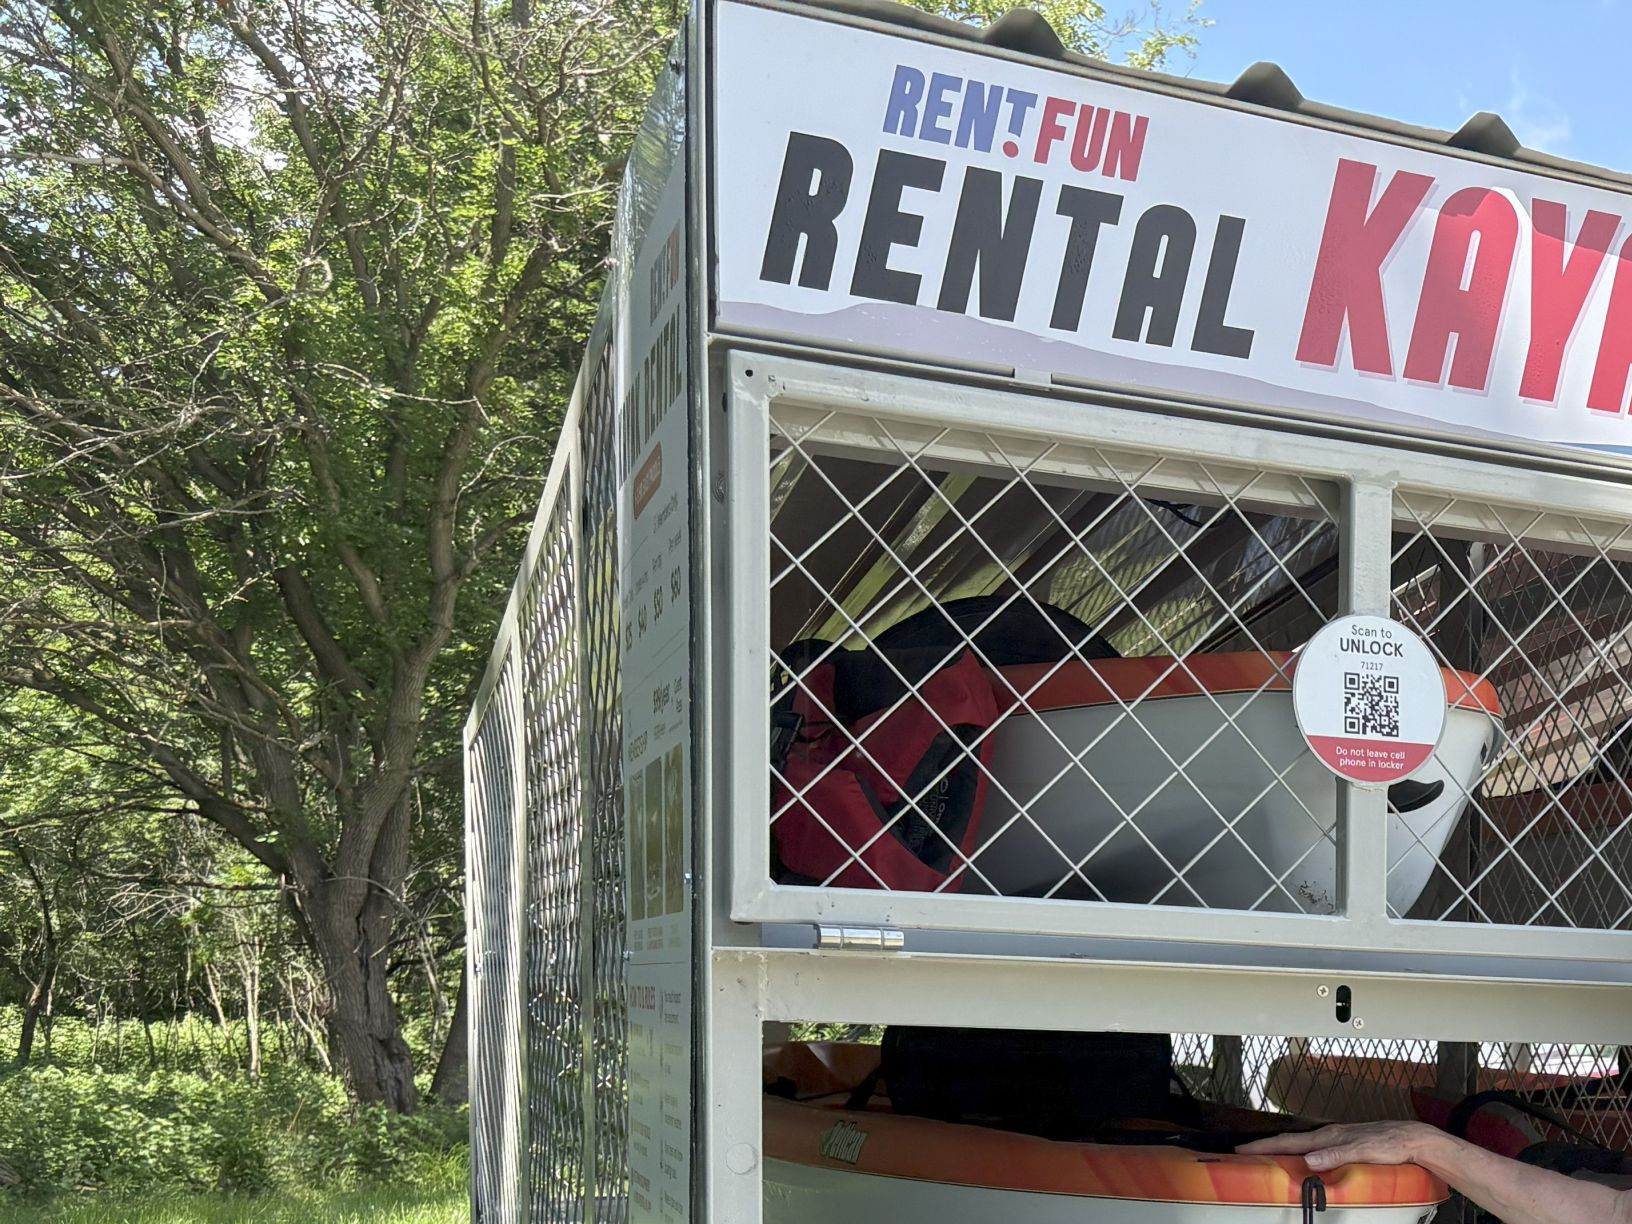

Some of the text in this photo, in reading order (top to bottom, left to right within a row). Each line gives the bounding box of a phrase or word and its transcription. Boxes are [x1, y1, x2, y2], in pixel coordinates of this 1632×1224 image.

[759, 130, 1255, 360] RENTAL
[645, 303, 682, 445] RENTAL
[1352, 625, 1392, 639] Scan to
[1340, 638, 1403, 657] UNLOCK
[1360, 662, 1383, 671] 71217
[1336, 746, 1405, 759] Do not leave cell
[1339, 758, 1404, 770] phone in locker
